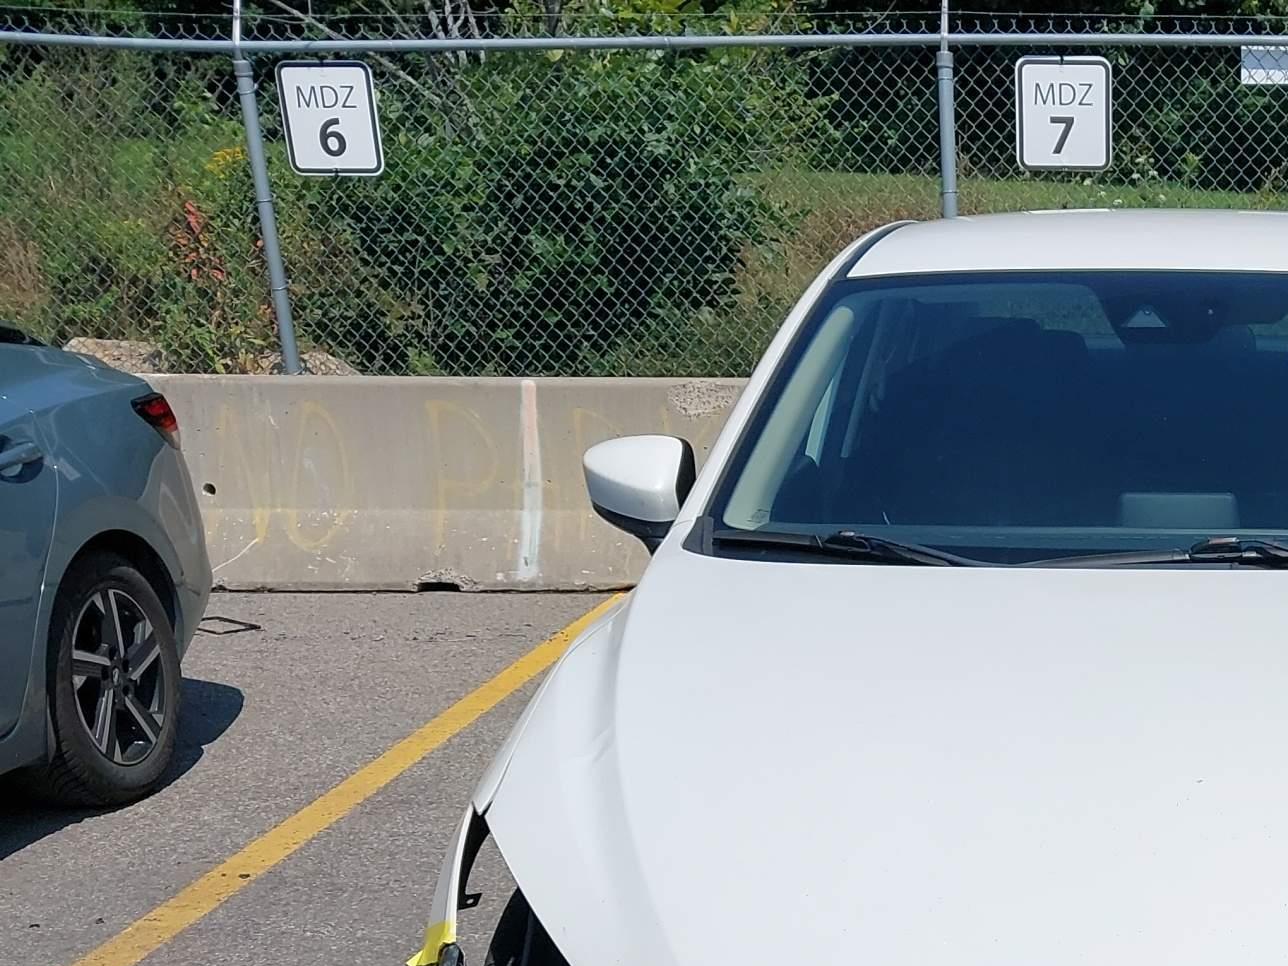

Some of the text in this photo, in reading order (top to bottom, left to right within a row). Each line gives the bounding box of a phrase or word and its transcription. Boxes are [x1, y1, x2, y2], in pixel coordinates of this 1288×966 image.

[295, 85, 358, 109] MDZ
[1034, 82, 1094, 107] MDZ
[319, 117, 347, 157] 6
[1049, 116, 1075, 155] 7
